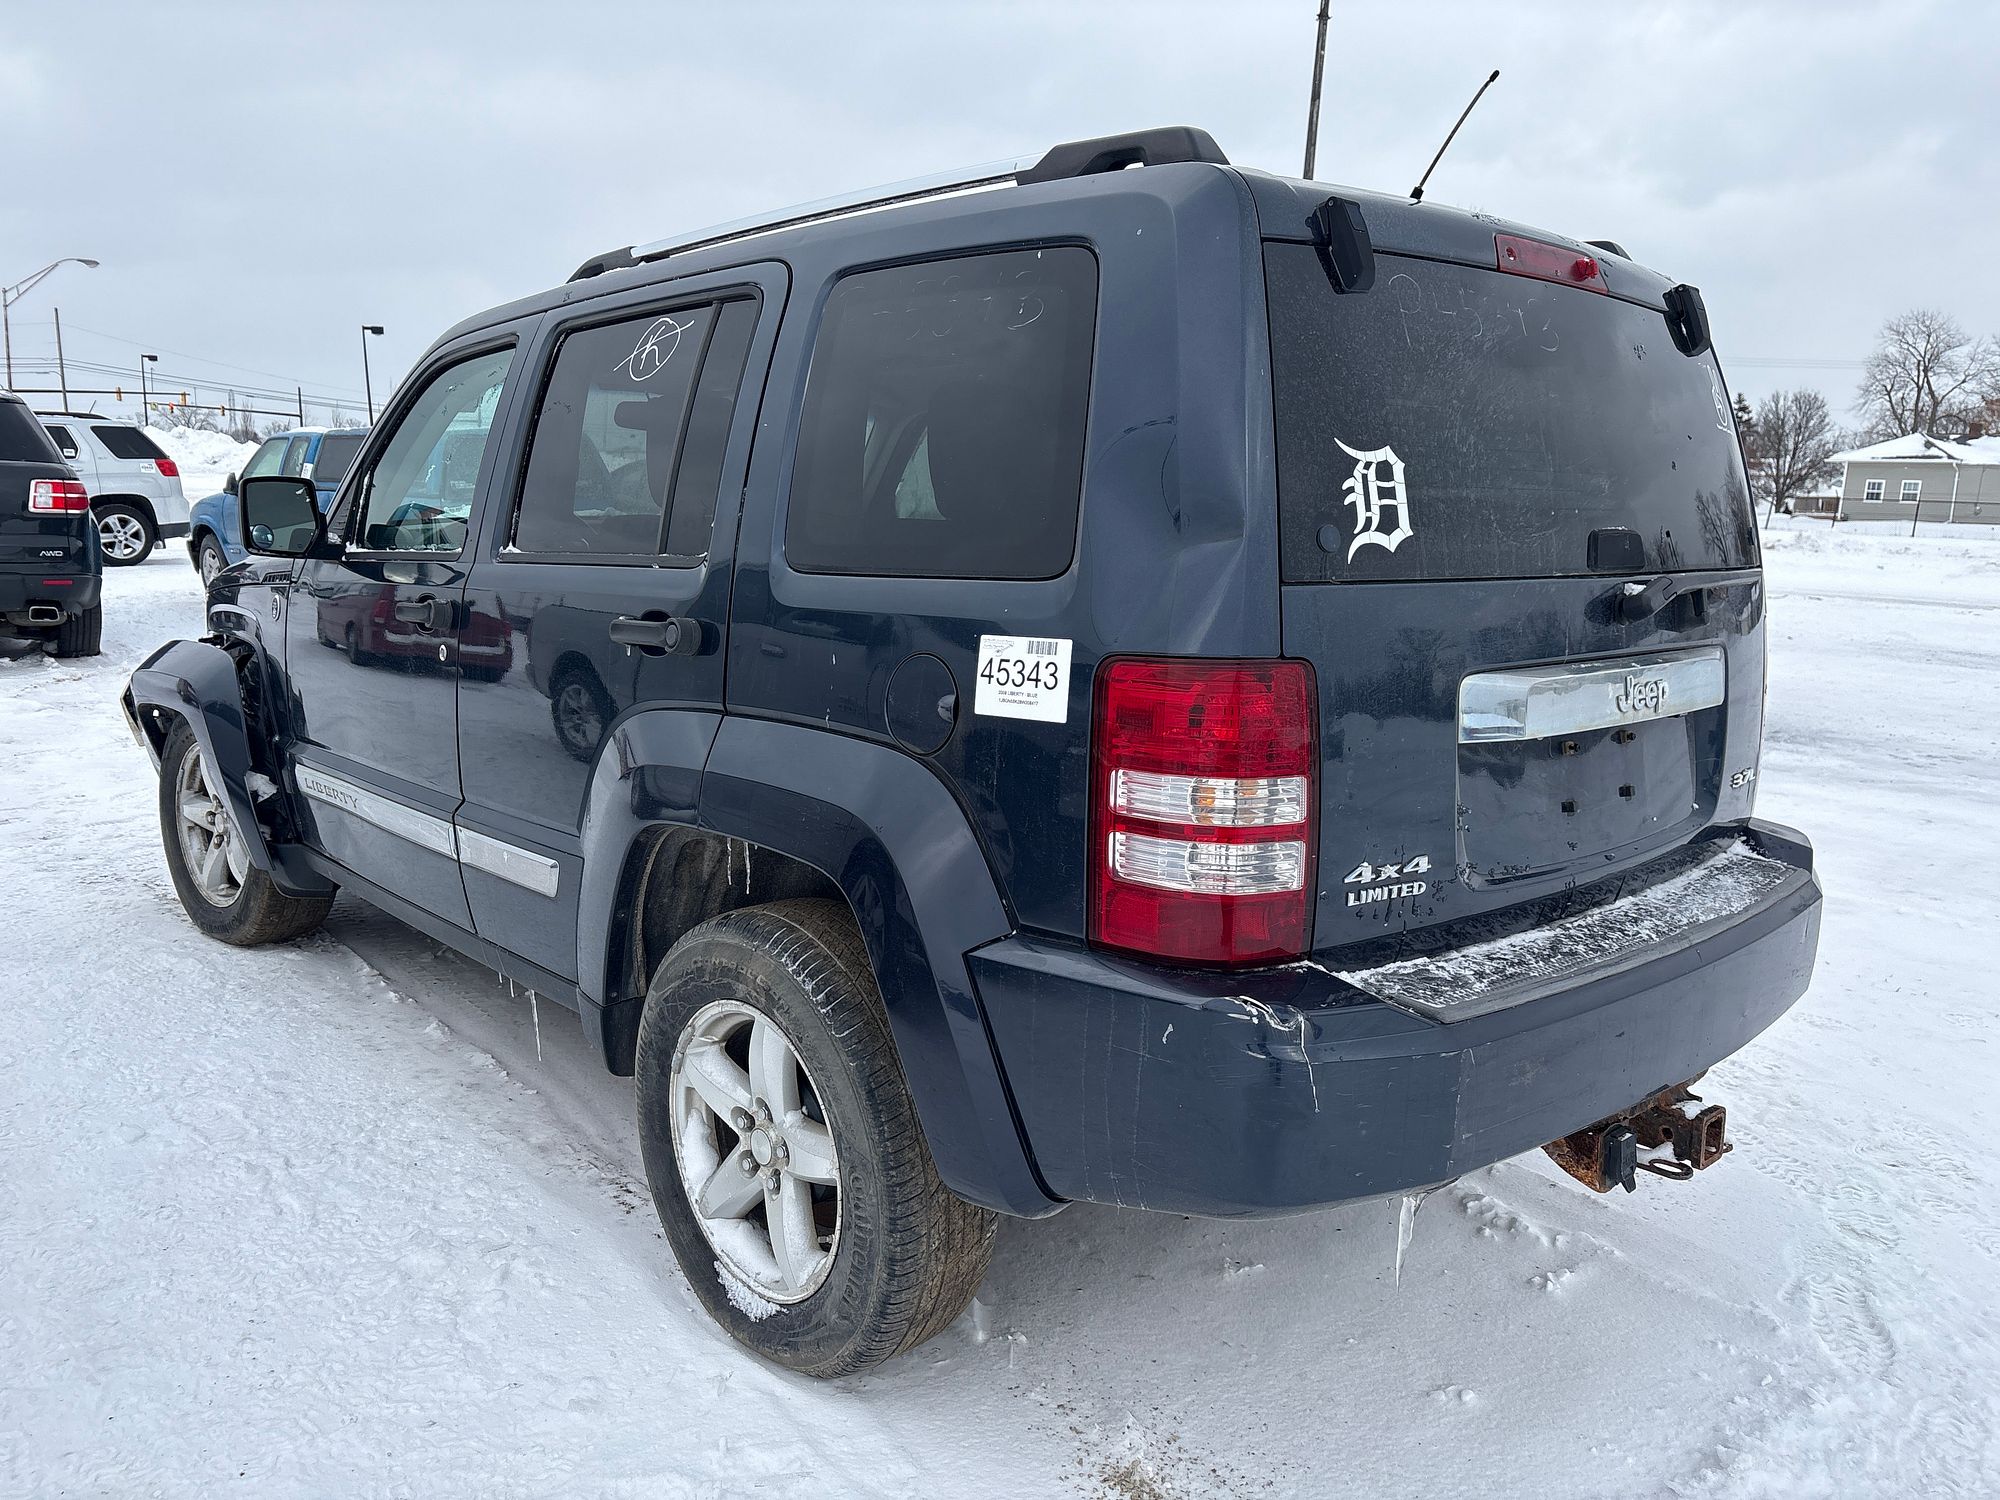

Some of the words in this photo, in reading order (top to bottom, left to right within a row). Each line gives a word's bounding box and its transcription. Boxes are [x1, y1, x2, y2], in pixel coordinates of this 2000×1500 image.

[980, 657, 1059, 691] 45343
[1616, 675, 1669, 713] Jeep
[304, 777, 358, 809] LIBERTY
[1346, 880, 1427, 907] LIMITED
